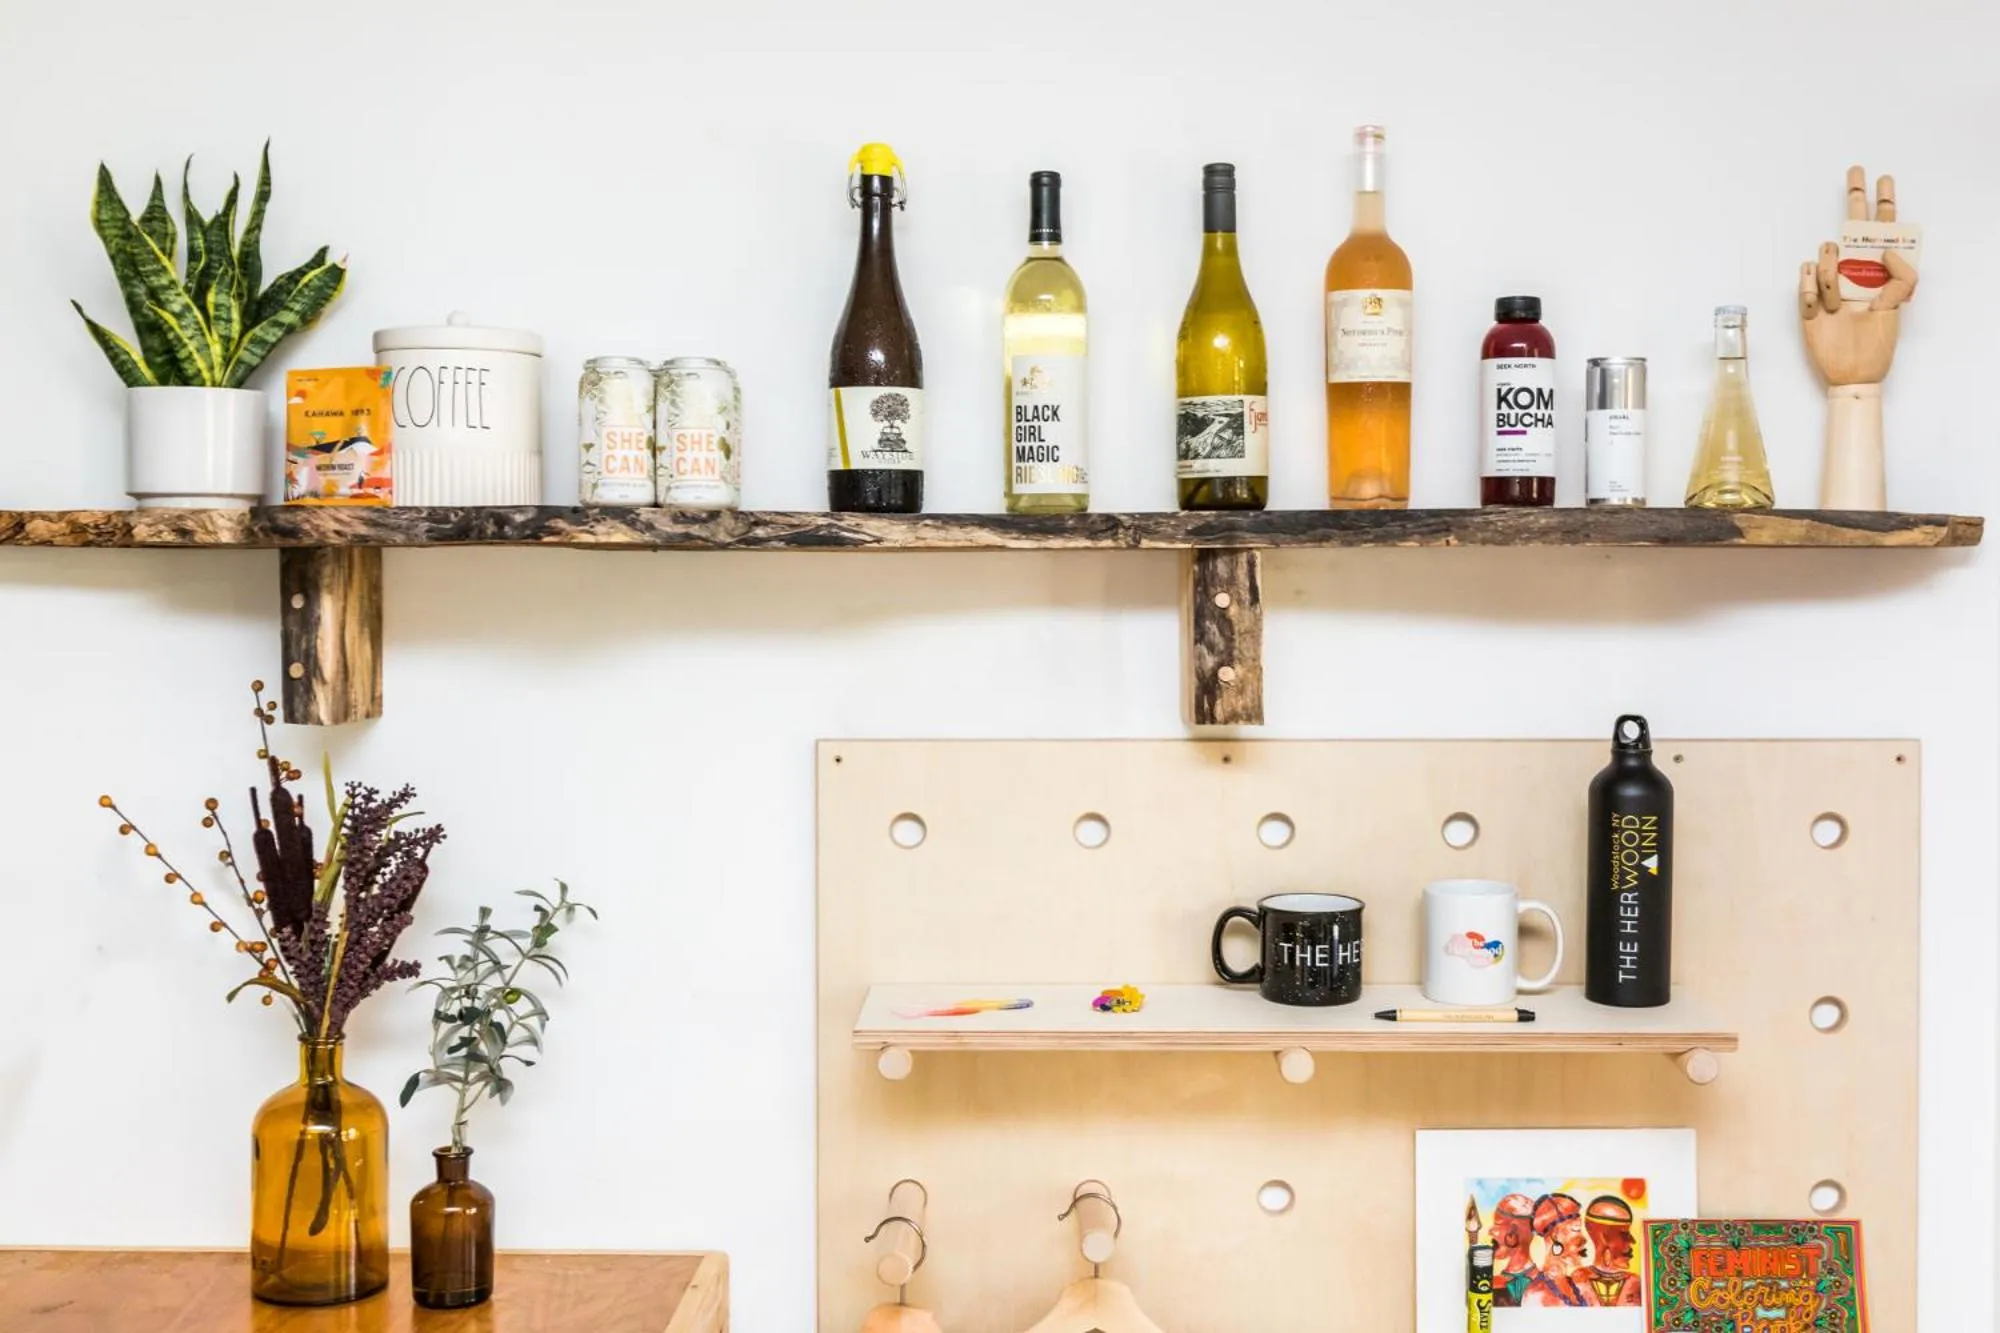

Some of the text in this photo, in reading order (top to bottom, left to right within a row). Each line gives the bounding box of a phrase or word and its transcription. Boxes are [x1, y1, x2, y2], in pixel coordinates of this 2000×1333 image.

[391, 366, 491, 430] COFFEE
[1496, 387, 1554, 411] KOM
[1016, 404, 1061, 422] BLACK
[1496, 412, 1554, 429] BUCHA
[606, 431, 645, 452] SHE
[676, 433, 716, 453] SHE
[1016, 425, 1046, 443] GIRL
[605, 453, 645, 475] CAN
[1016, 445, 1061, 463] MAGIC
[676, 456, 717, 477] CAN
[1641, 816, 1659, 853] INN
[1611, 811, 1622, 891] Woodstock, NY
[1280, 940, 1361, 967] THE HE
[1618, 942, 1639, 983] THE
[1691, 1246, 1822, 1278] FEMINIST
[1690, 1277, 1818, 1322] Coloring
